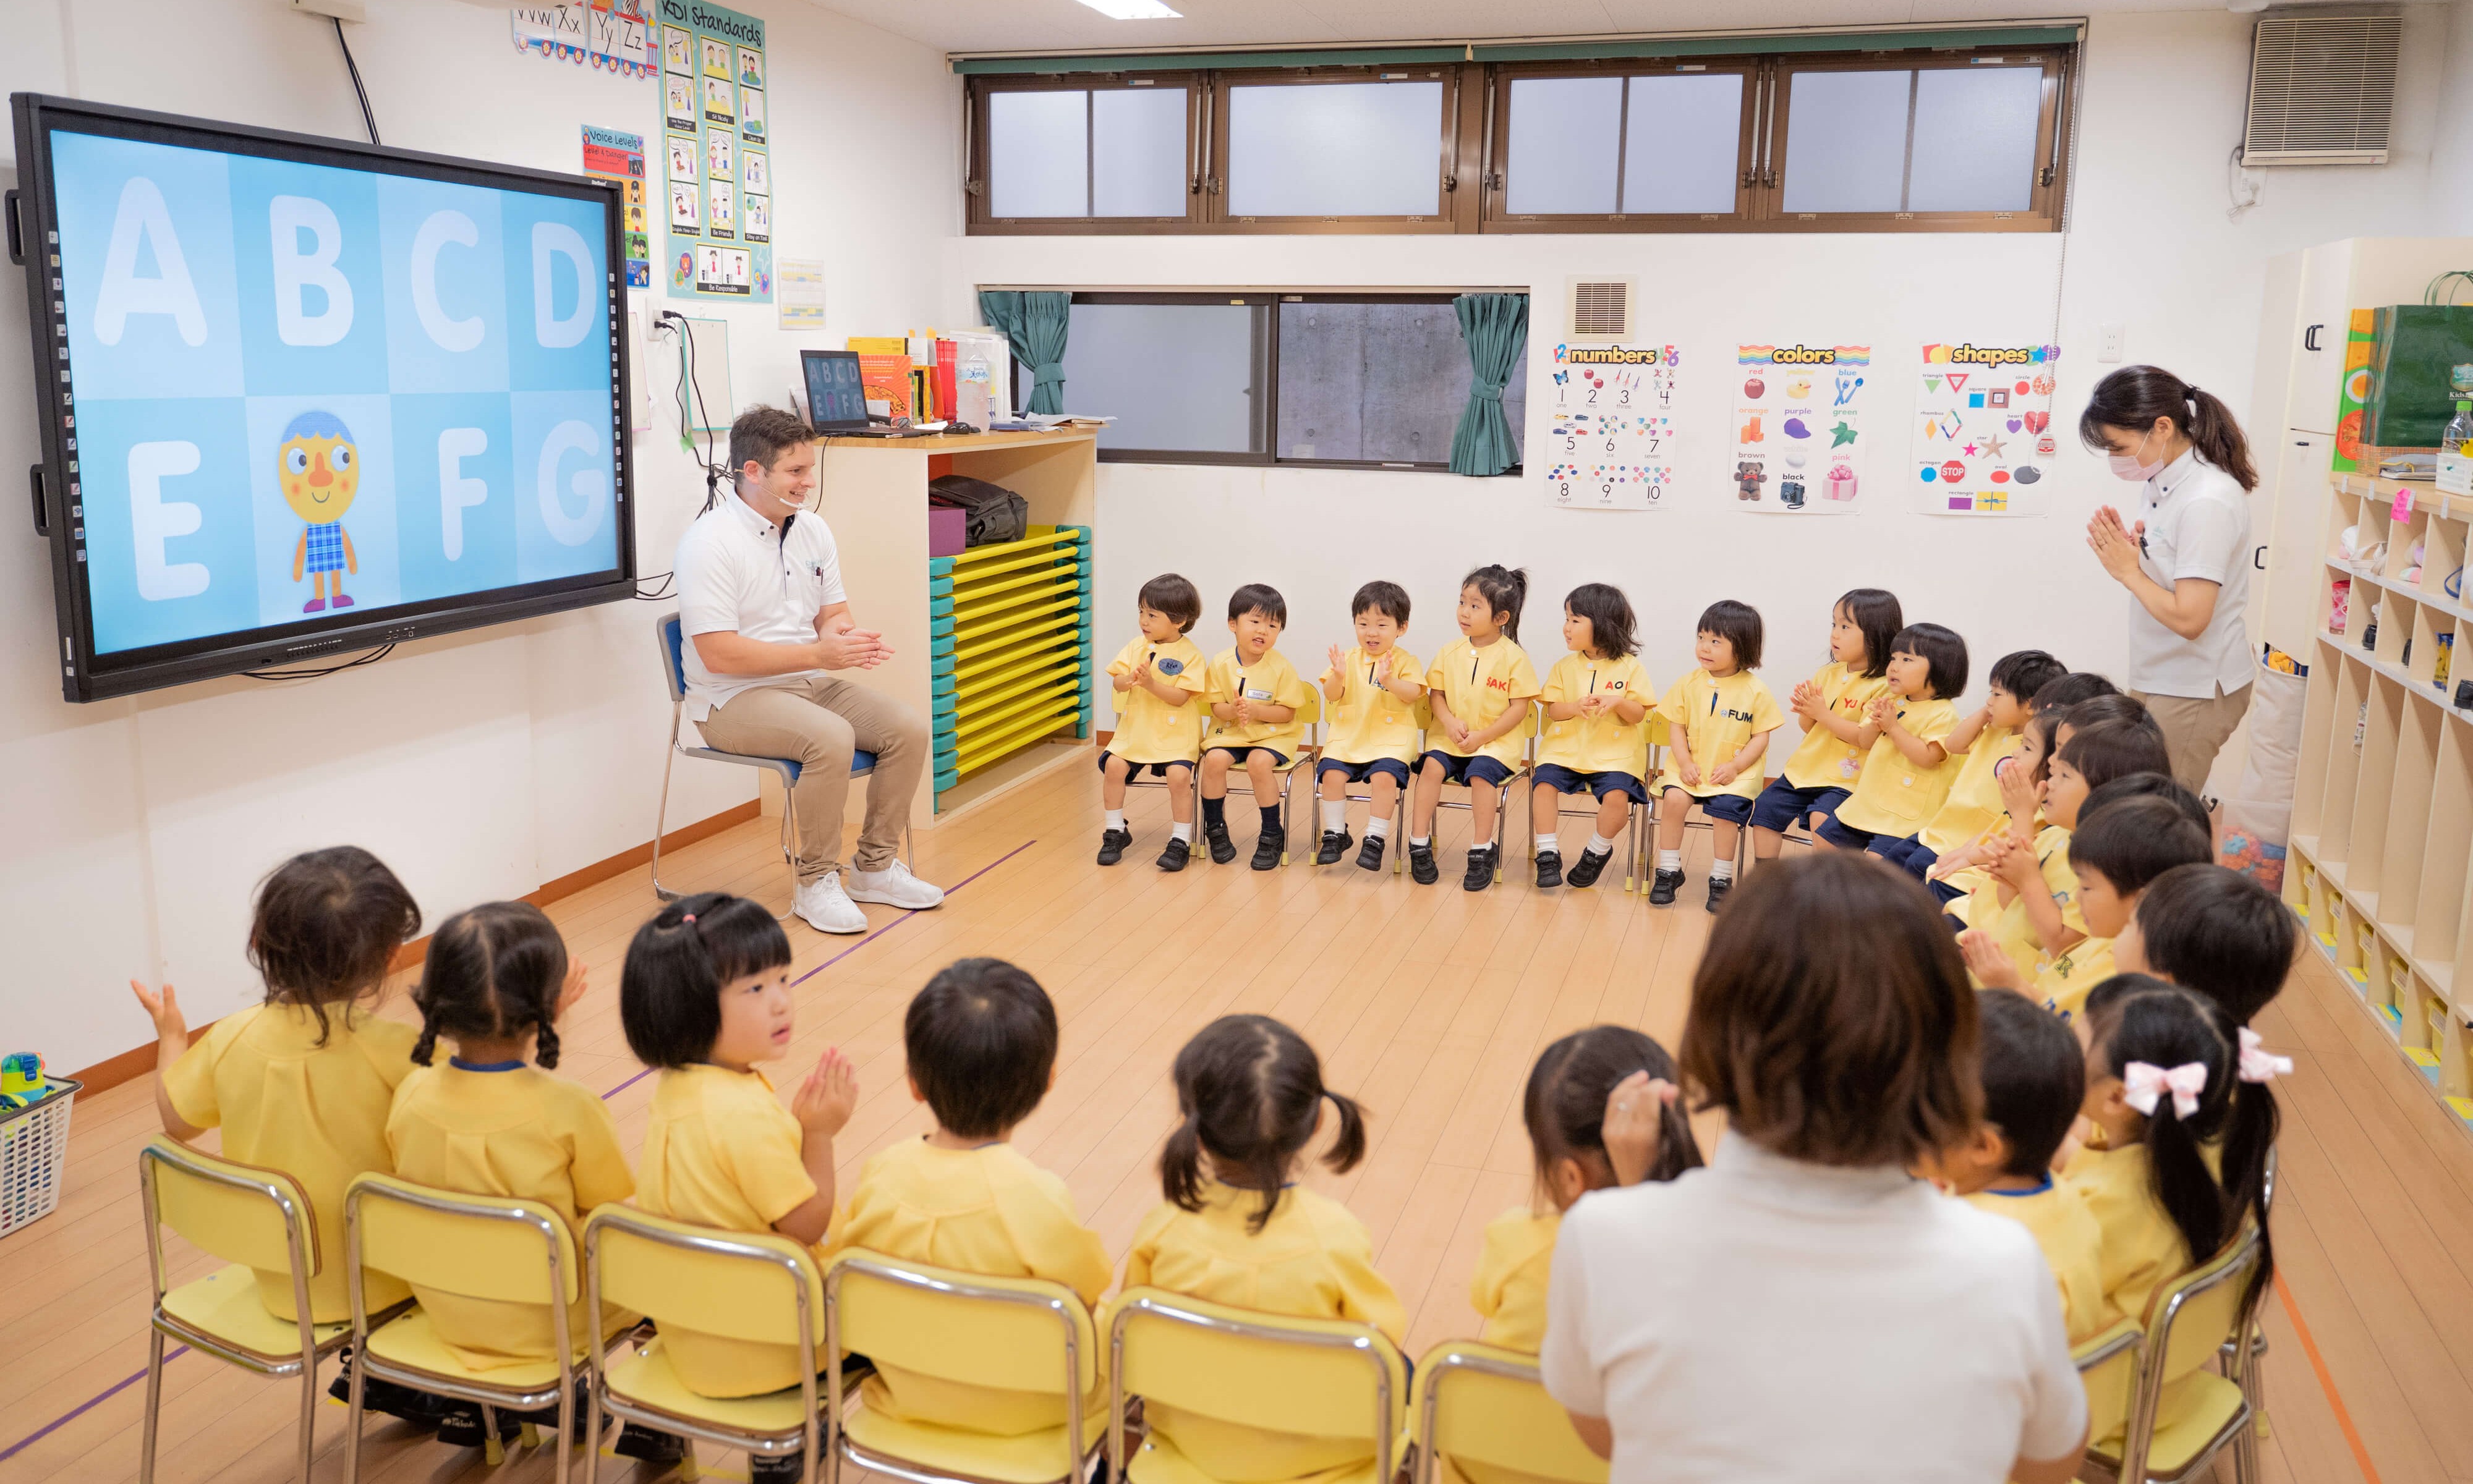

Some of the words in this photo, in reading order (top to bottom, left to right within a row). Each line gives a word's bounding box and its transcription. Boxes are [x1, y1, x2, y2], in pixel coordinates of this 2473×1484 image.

[559, 7, 580, 33] Xx
[596, 12, 613, 53] Yy
[624, 21, 642, 50] Zz
[692, 7, 762, 47] Standards
[590, 130, 613, 143] Voice
[615, 135, 638, 150] Levels
[94, 177, 208, 347] A
[270, 195, 354, 346] B
[411, 210, 485, 352] C
[531, 221, 598, 348] D
[1571, 345, 1656, 365] numbers
[1772, 344, 1836, 364] colors
[1951, 343, 2029, 368] shapes
[810, 362, 820, 383] A
[822, 362, 832, 383] B
[835, 362, 845, 383] C
[848, 362, 858, 382] D
[815, 394, 824, 416] E
[842, 394, 849, 415] F
[854, 394, 864, 415] G
[1588, 389, 1596, 403] 2
[1620, 390, 1629, 404] 3
[1660, 391, 1669, 404] 4
[1567, 437, 1575, 450] 5
[1606, 438, 1615, 451] 6
[1649, 439, 1659, 452] 7
[1941, 467, 1964, 477] STOP
[1560, 483, 1569, 496] 8
[1602, 484, 1611, 498] 9
[1648, 486, 1660, 499] 10
[127, 440, 210, 601] E
[438, 426, 488, 561] F
[537, 420, 607, 546] G
[1605, 681, 1628, 690] AOI
[2054, 954, 2074, 978] K
